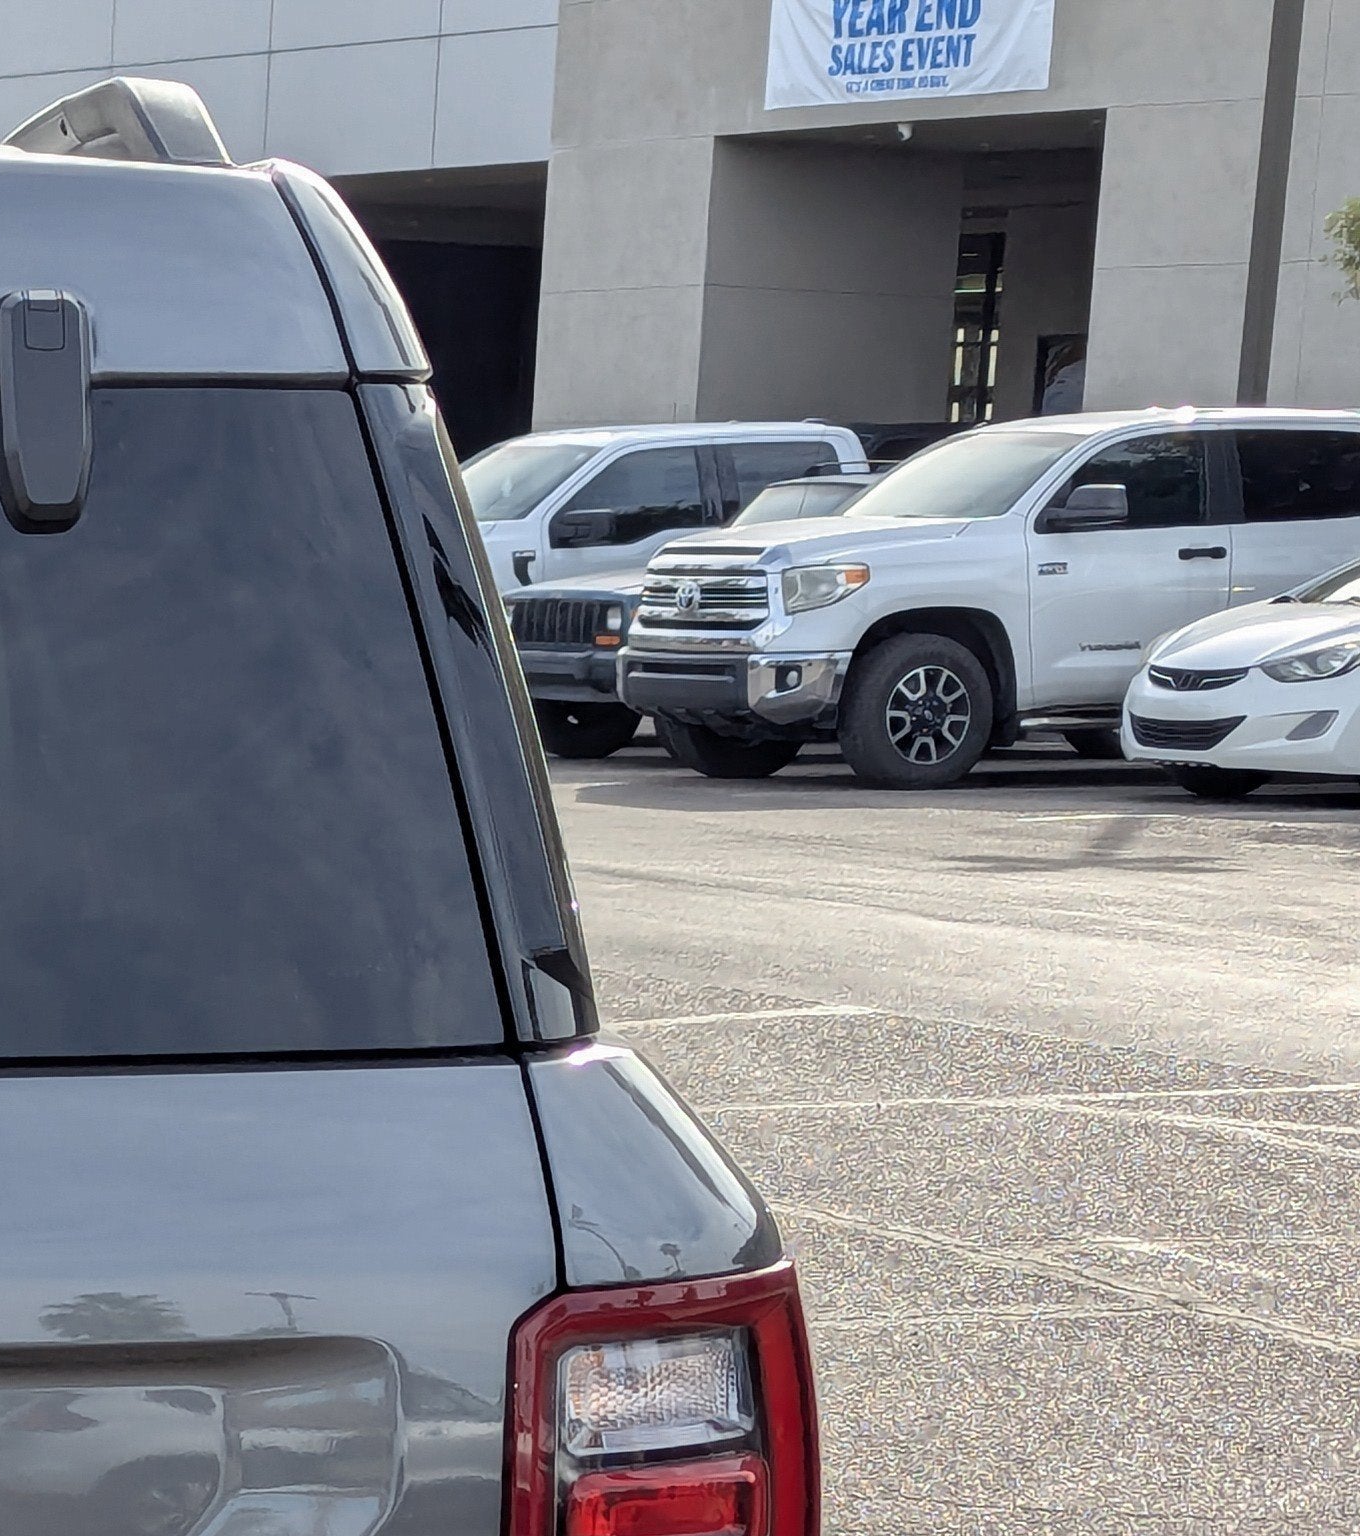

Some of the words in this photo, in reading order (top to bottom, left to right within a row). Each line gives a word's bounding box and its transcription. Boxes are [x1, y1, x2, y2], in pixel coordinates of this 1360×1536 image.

[833, 0, 909, 38] YEAR
[915, 0, 981, 32] END
[828, 39, 896, 76] SALES
[900, 33, 976, 72] EVENT
